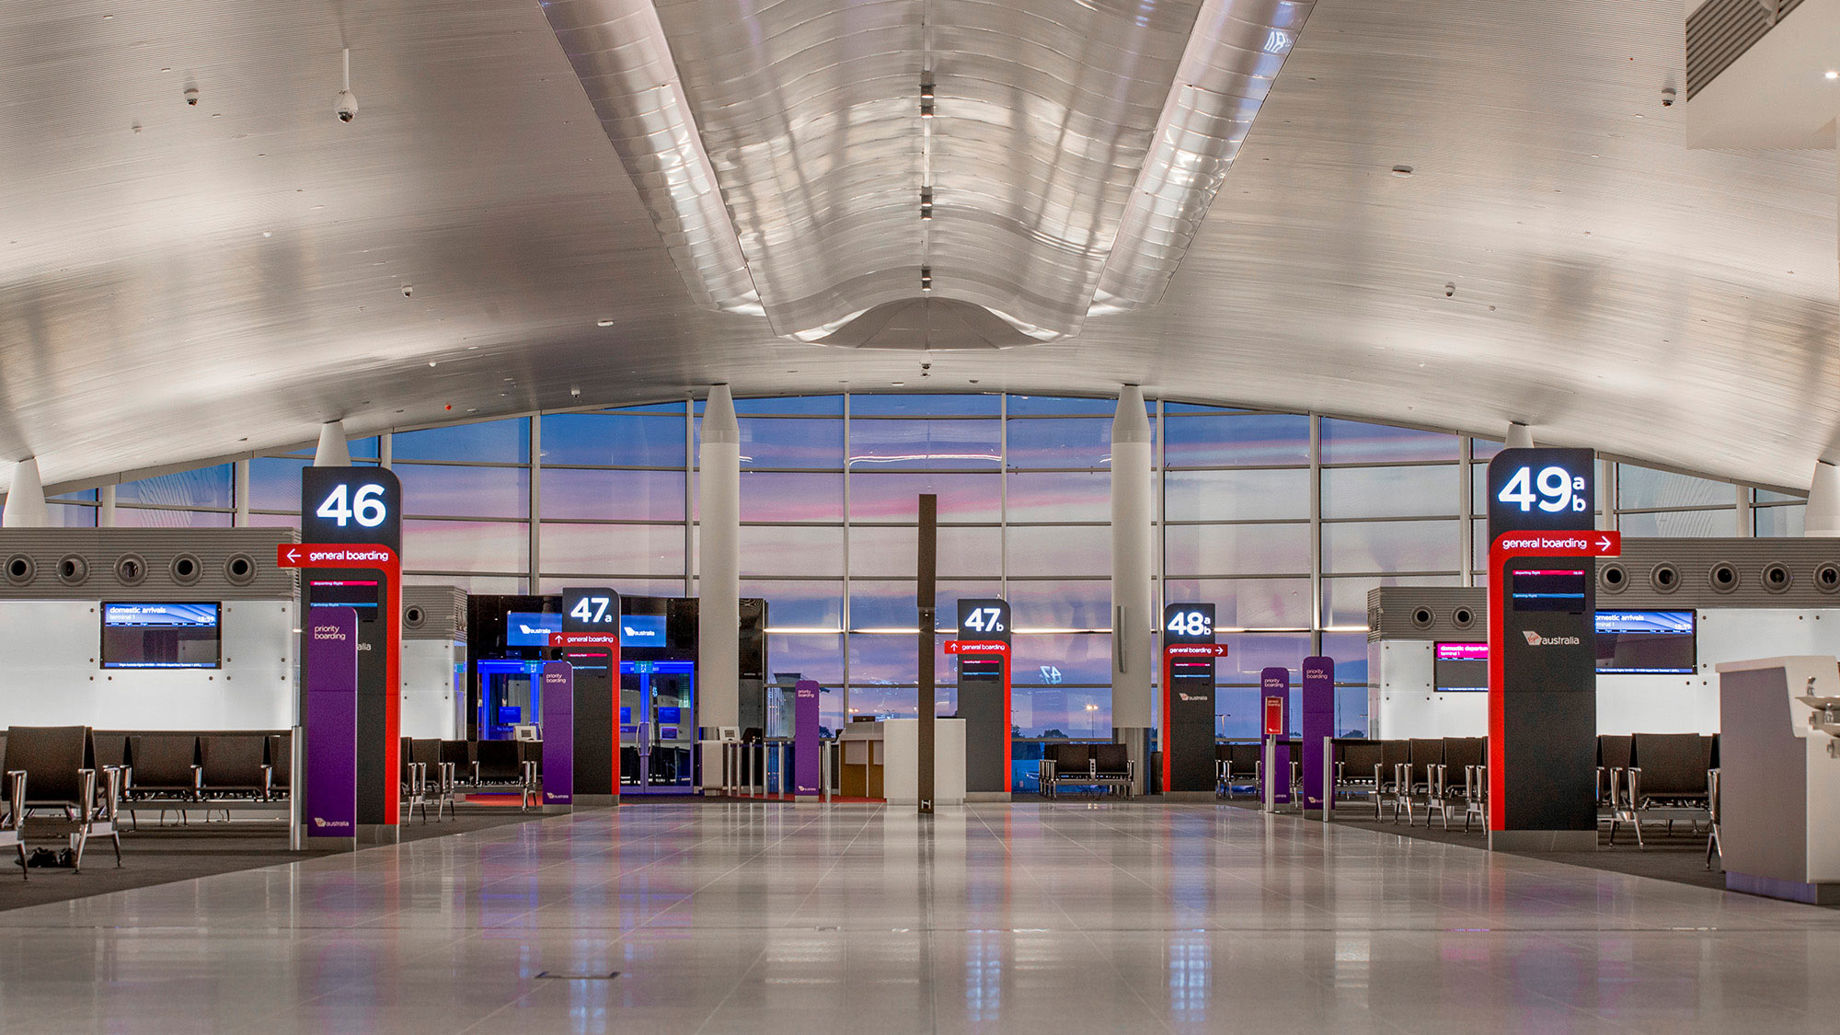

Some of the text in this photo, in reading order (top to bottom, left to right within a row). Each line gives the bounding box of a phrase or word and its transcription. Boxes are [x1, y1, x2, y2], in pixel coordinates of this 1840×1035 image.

[1498, 465, 1572, 513] 49
[316, 483, 386, 527] 46
[1502, 537, 1587, 550] general boarding
[309, 550, 389, 562] general boarding
[109, 606, 167, 614] domestic arrivals
[314, 625, 340, 633] priority
[567, 635, 614, 643] general boarding
[1541, 636, 1580, 645] australia
